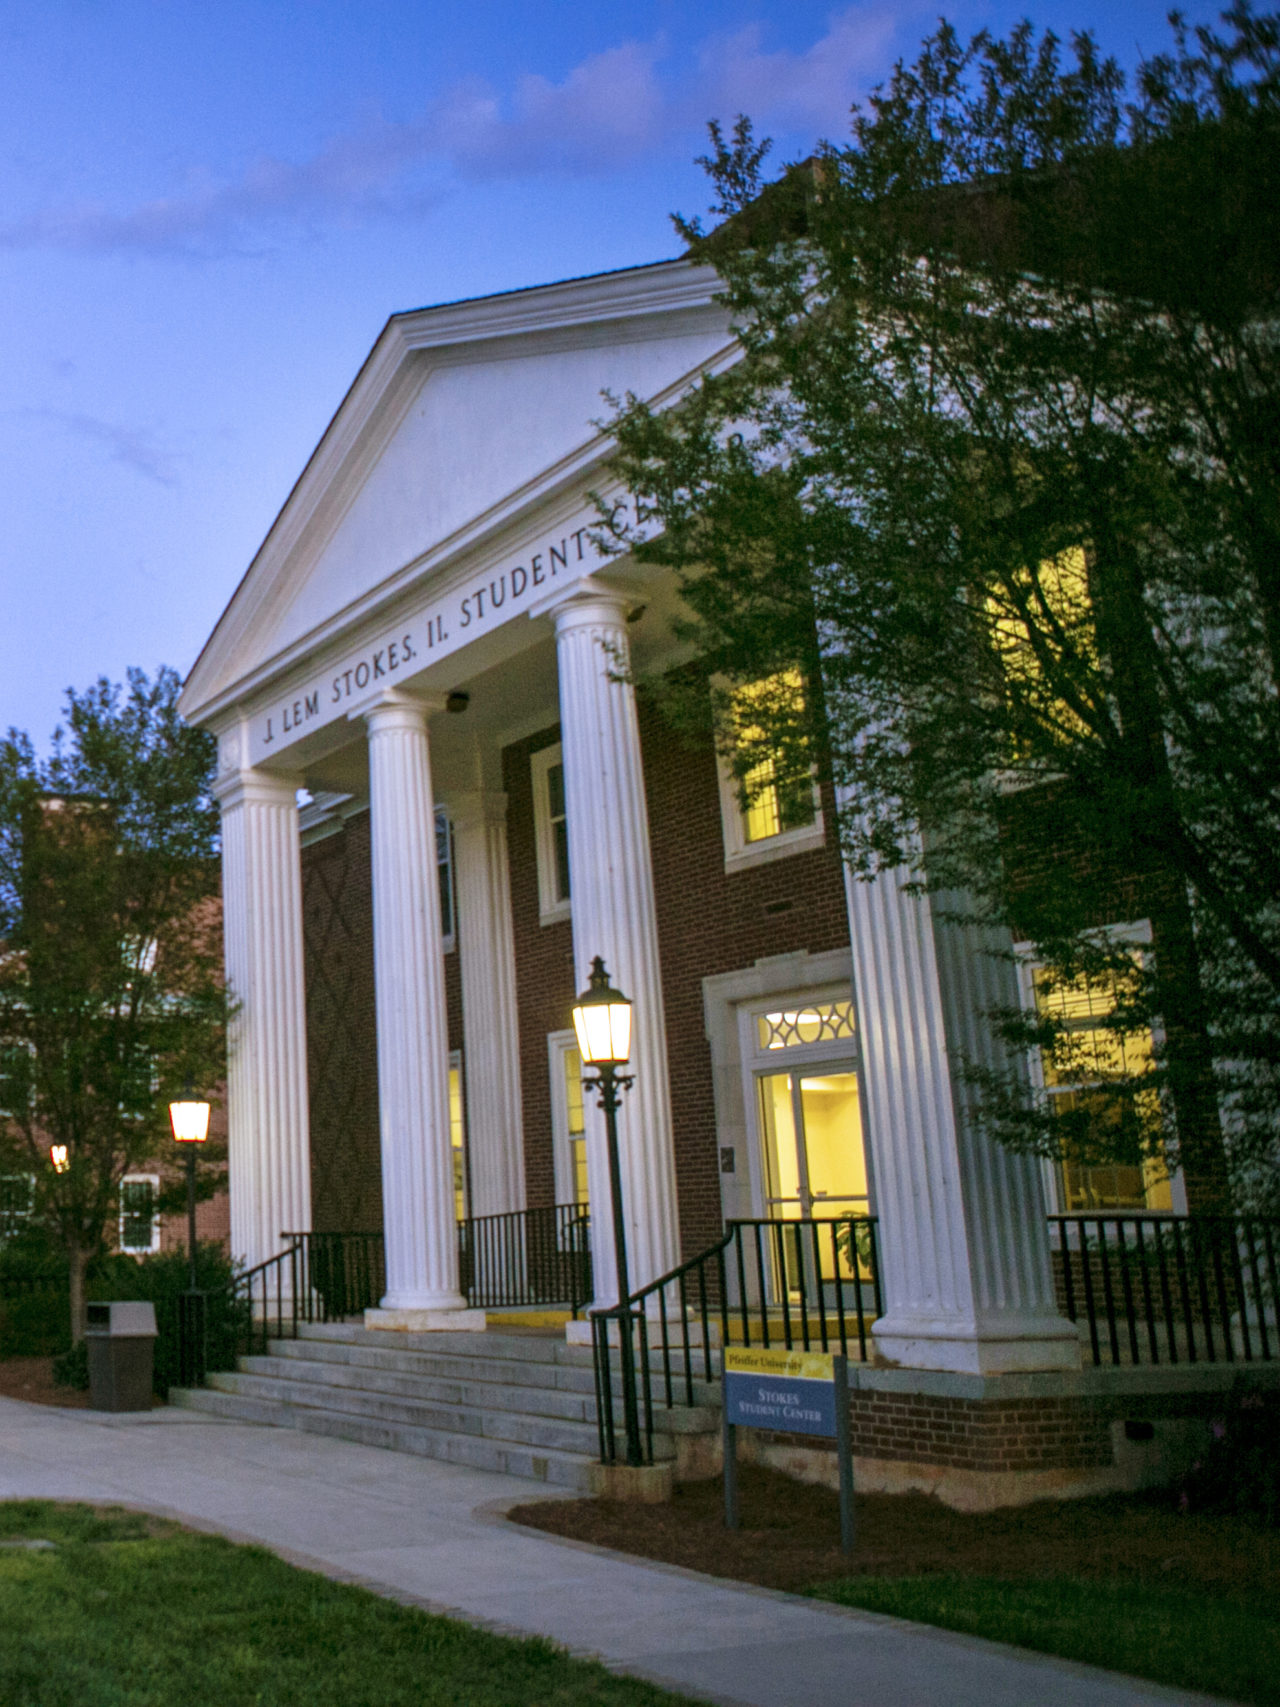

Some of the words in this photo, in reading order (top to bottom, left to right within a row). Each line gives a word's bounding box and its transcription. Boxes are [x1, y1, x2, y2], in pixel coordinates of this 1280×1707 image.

[283, 690, 319, 733] LEM
[460, 527, 587, 628] STUDENT
[760, 1357, 802, 1371] University
[758, 1388, 800, 1405] STOKES
[739, 1401, 781, 1417] STUDENT
[783, 1406, 822, 1422] CENTER
